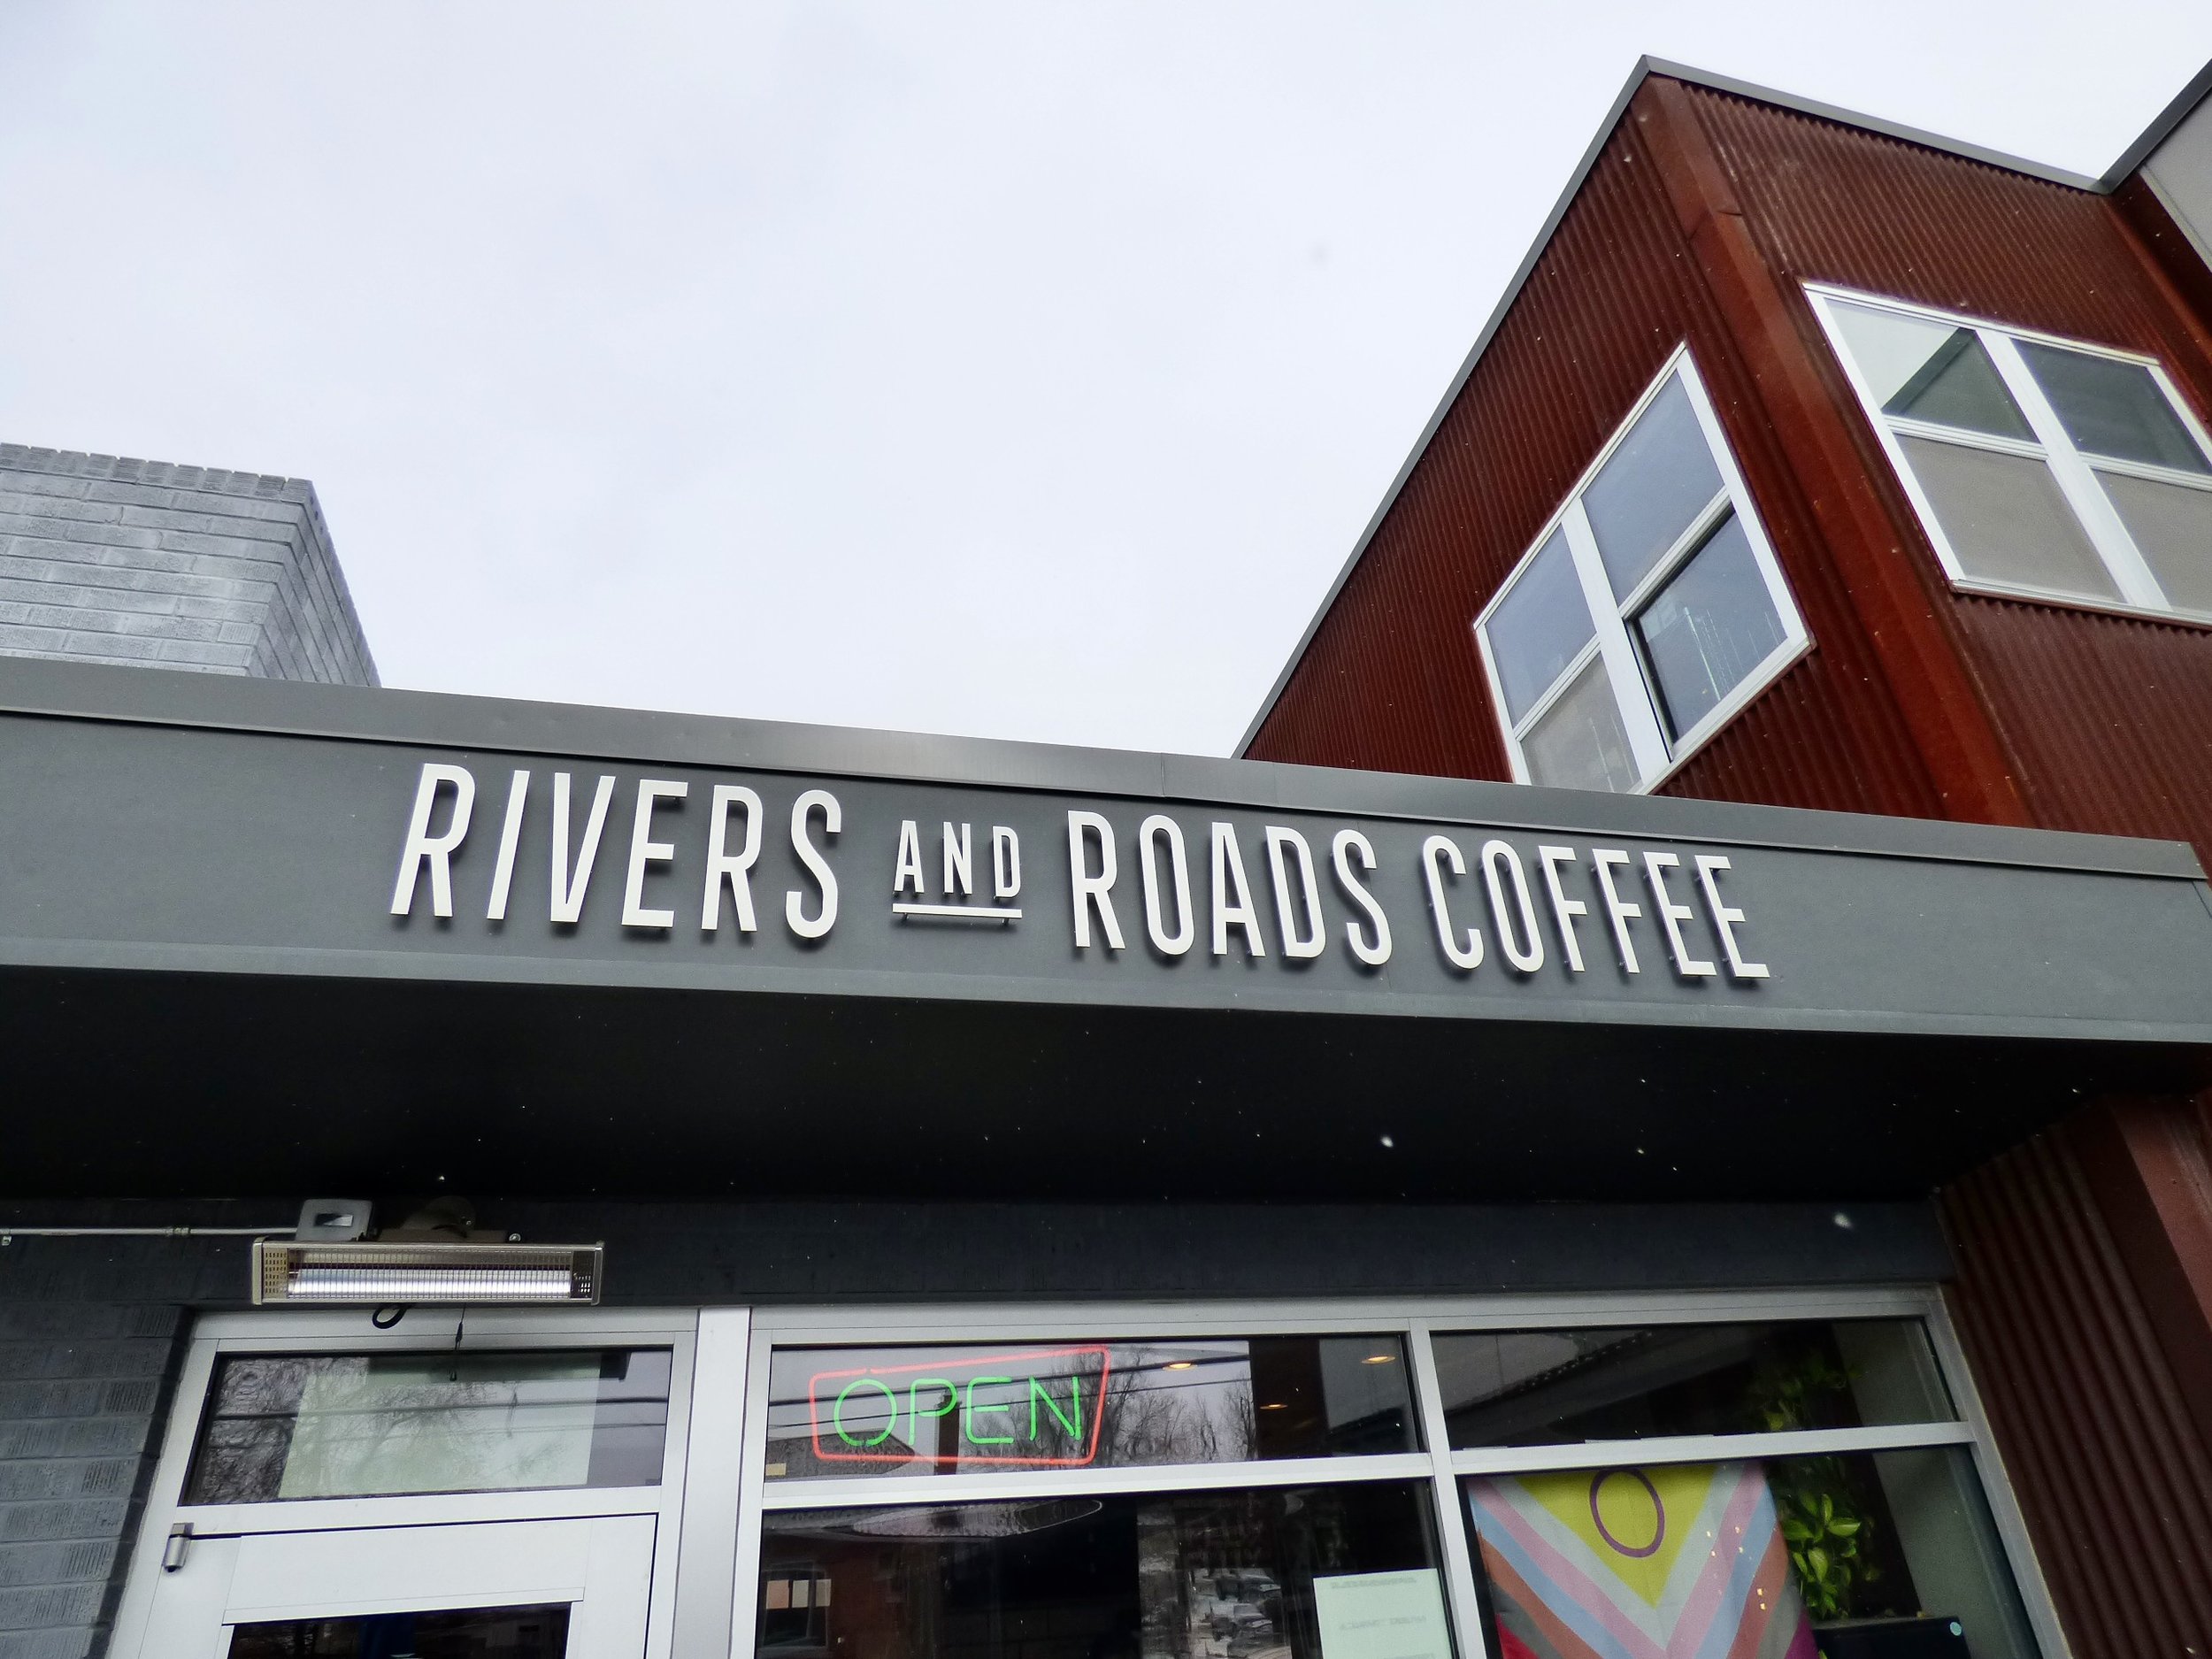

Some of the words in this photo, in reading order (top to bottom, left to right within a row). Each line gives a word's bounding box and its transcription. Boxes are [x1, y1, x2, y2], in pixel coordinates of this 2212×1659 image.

[390, 763, 841, 939] RIVERS
[893, 819, 1021, 899] AND
[1067, 810, 1392, 966] ROADS
[1423, 835, 1770, 978] COFFEE
[833, 1375, 1081, 1447] OPEN
